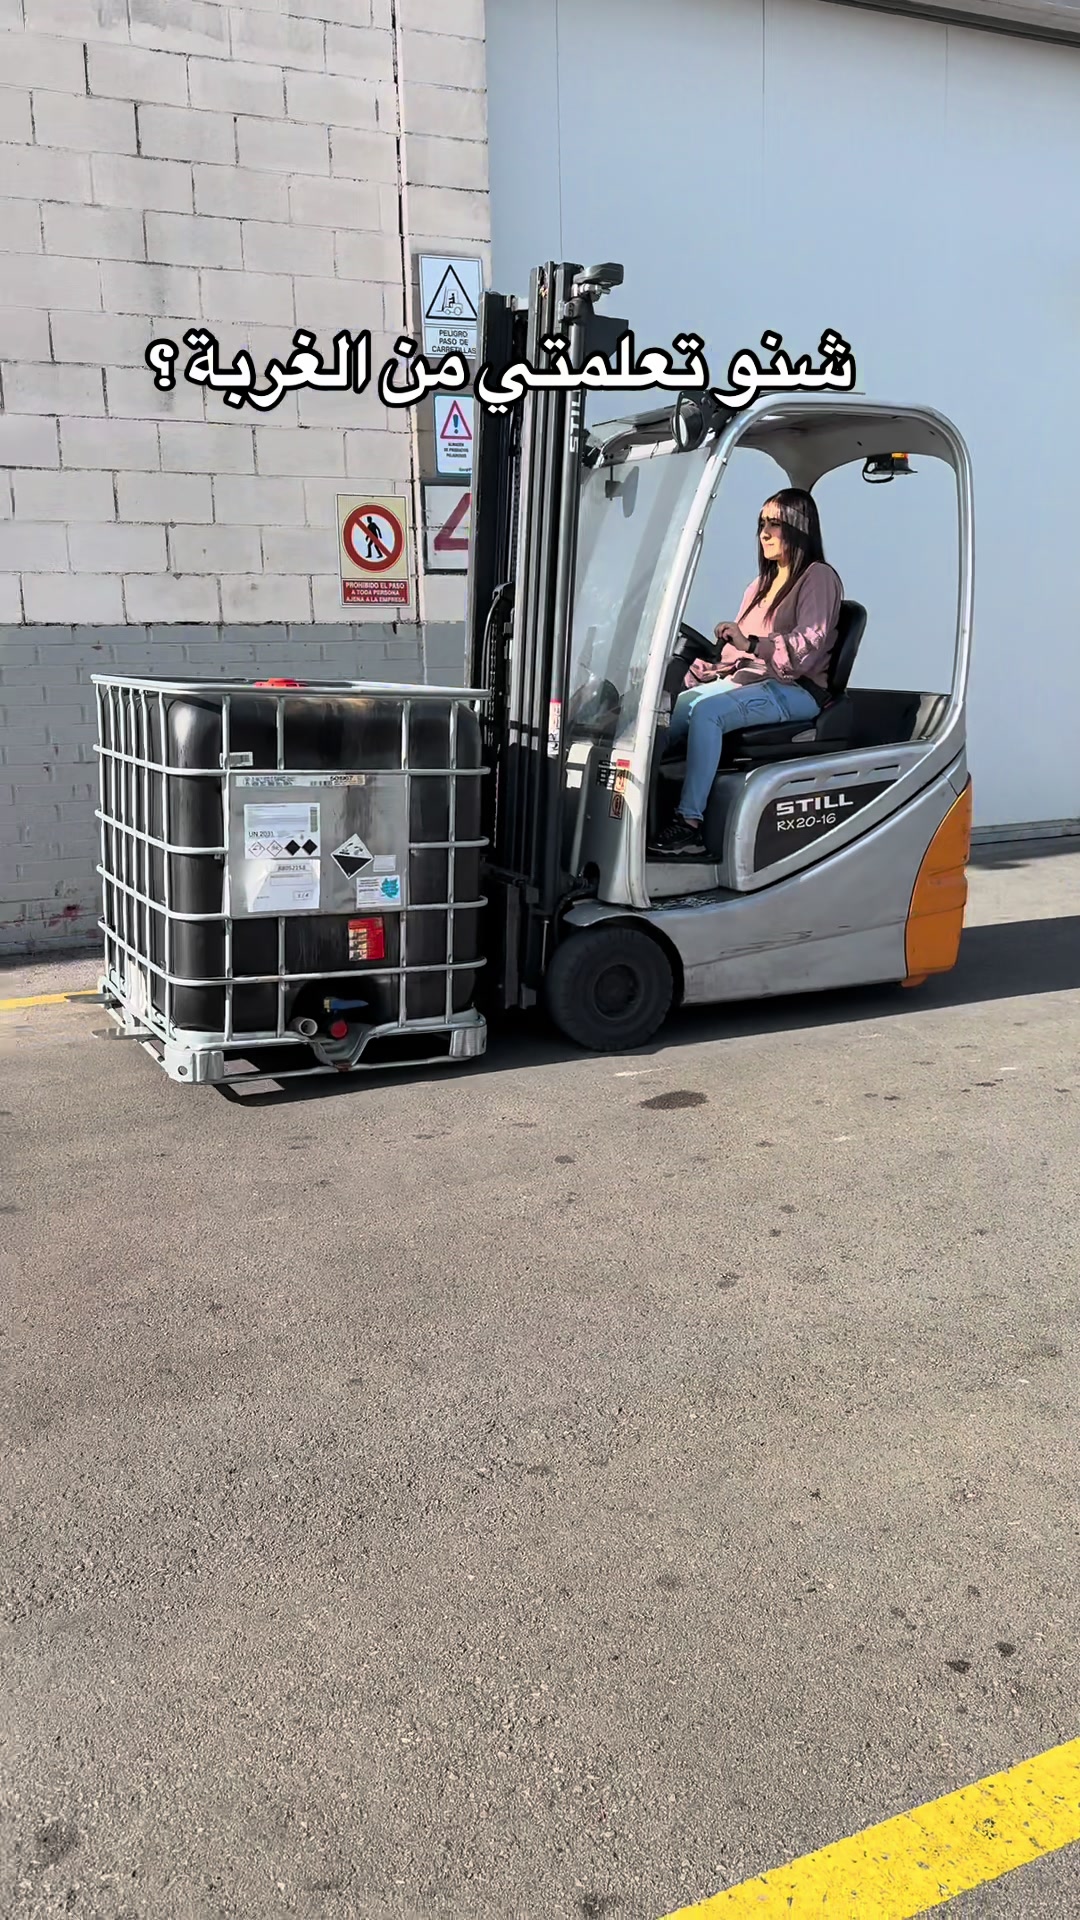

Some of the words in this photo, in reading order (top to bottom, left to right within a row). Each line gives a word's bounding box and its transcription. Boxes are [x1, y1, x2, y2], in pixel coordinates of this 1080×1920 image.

[432, 346, 476, 354] CARRETILLAS
[569, 389, 581, 453] STIL
[776, 793, 854, 816] STILL
[777, 813, 836, 832] RX20-16
